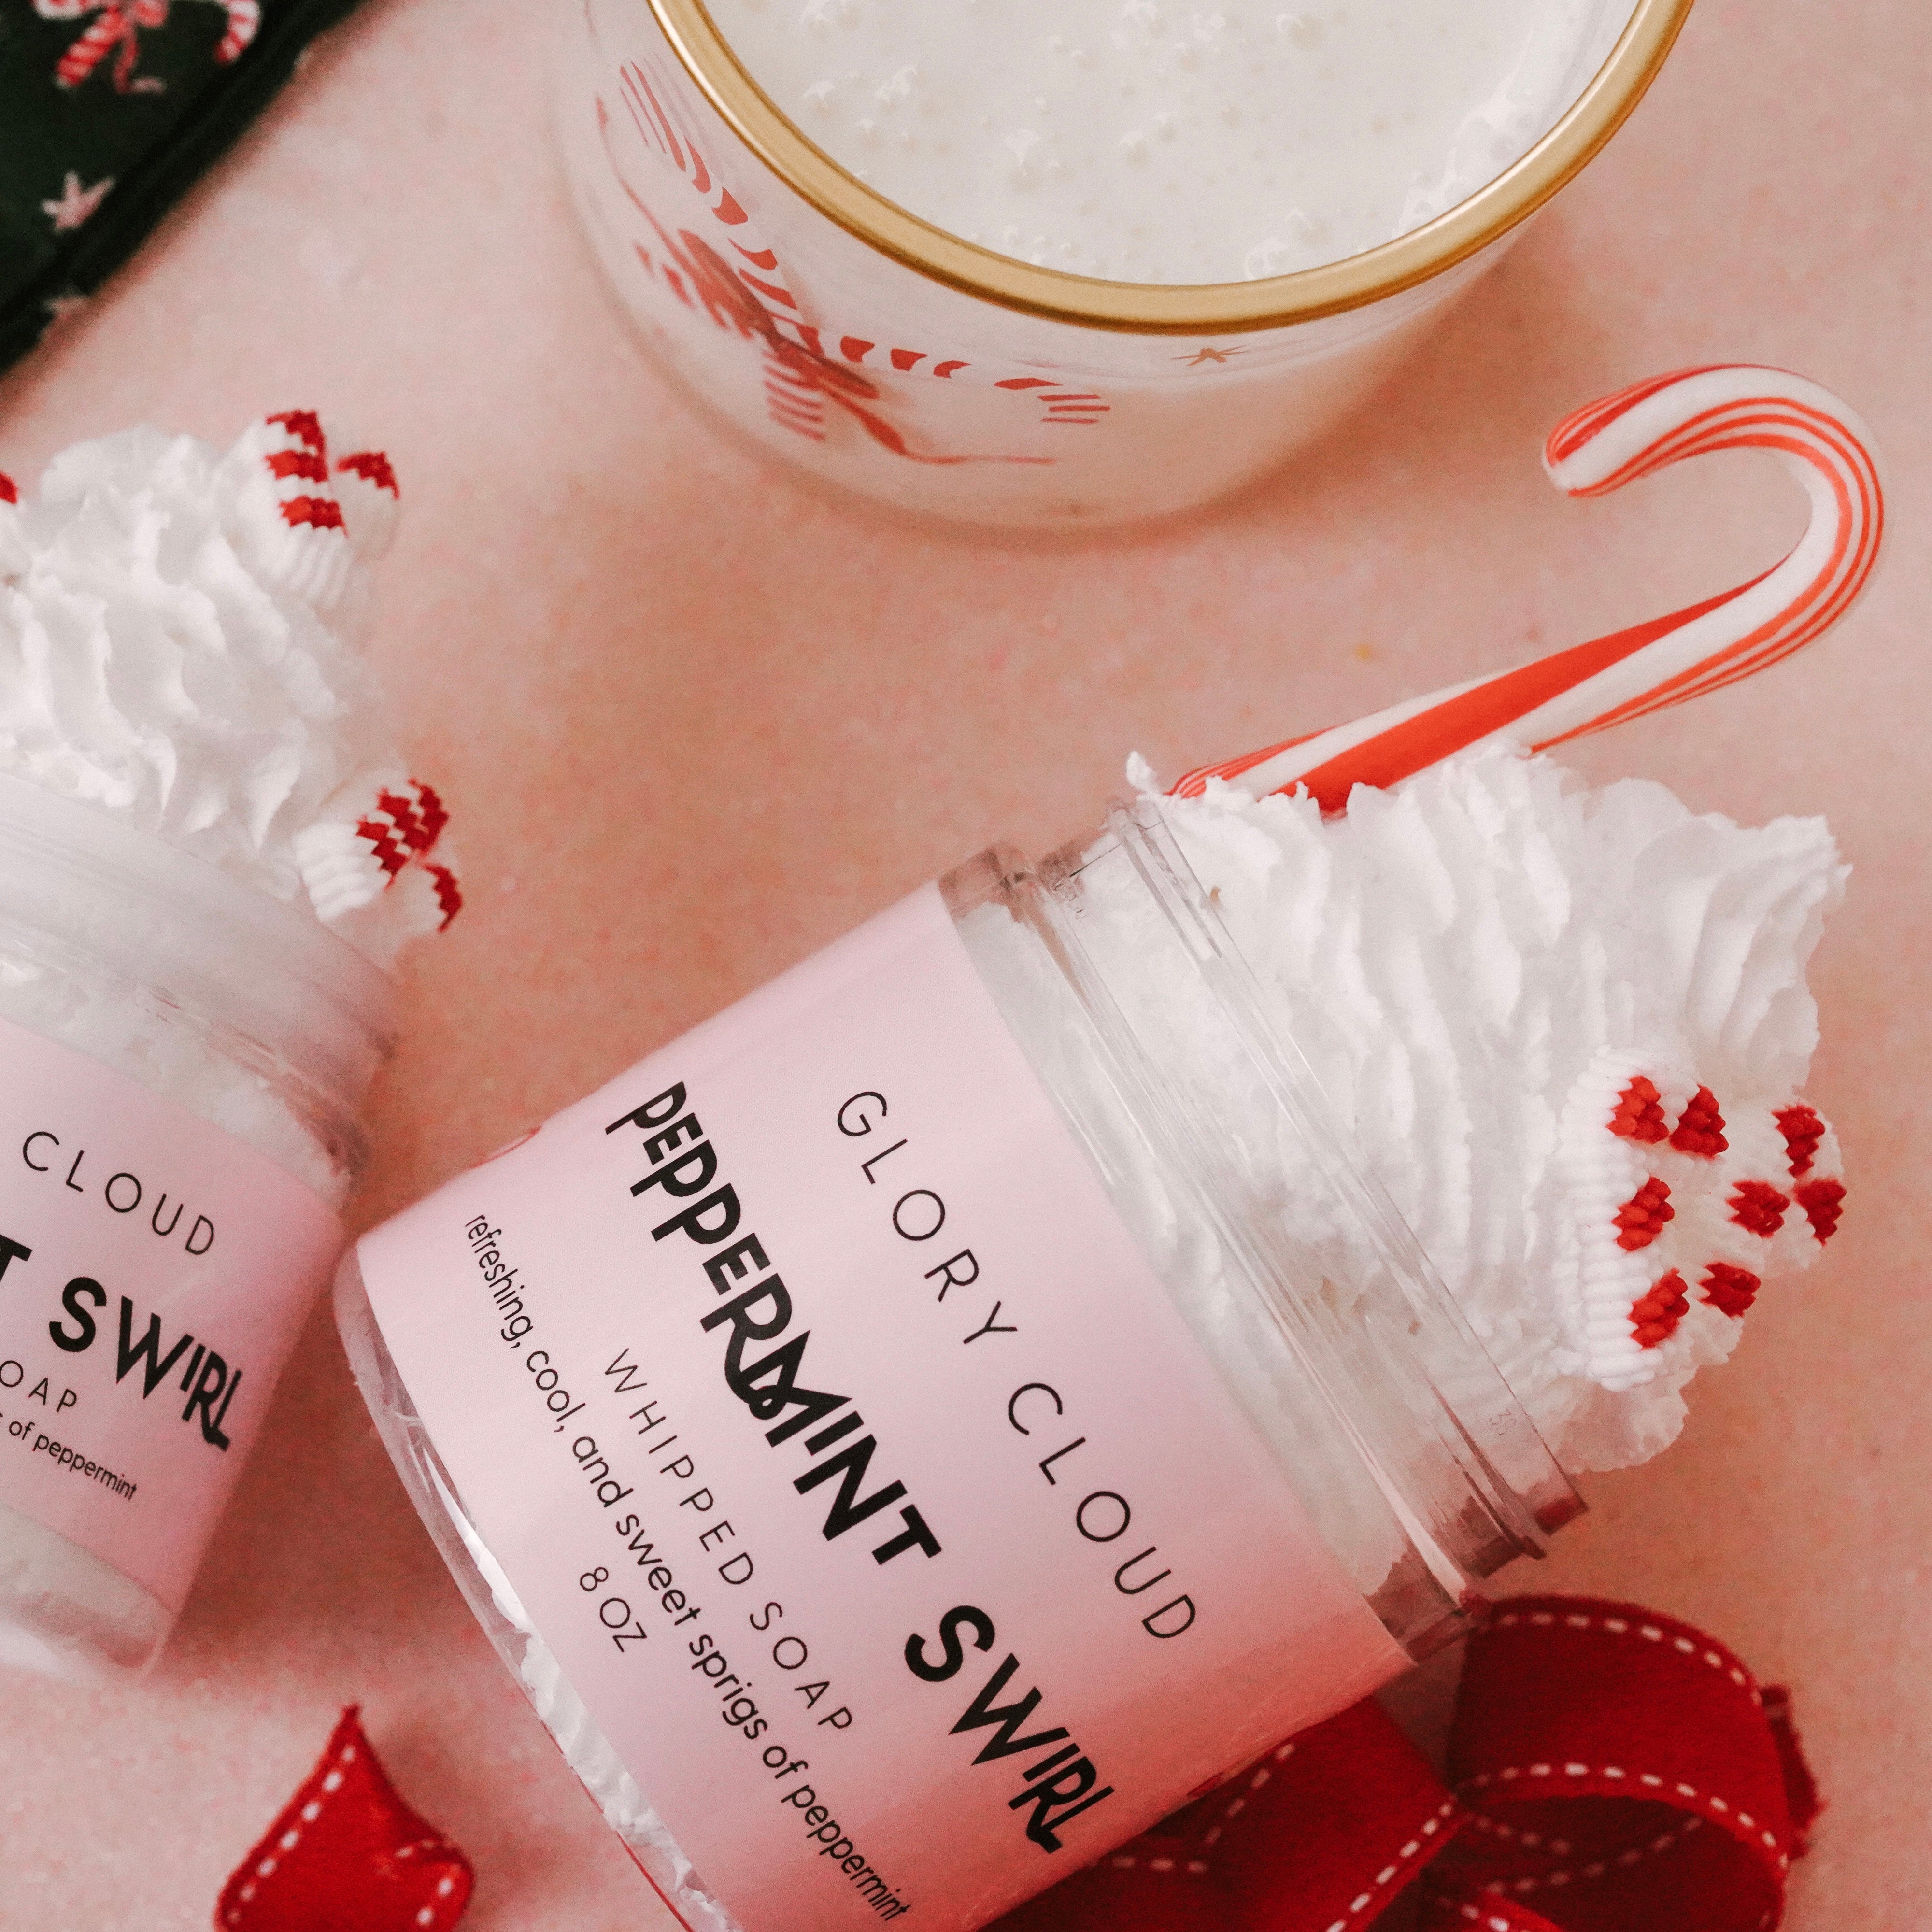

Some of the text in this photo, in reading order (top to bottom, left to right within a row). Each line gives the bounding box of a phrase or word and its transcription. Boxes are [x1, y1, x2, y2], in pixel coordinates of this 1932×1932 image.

[23, 1131, 214, 1255] CLOUD
[0, 1360, 77, 1412] OAP
[49, 1277, 242, 1451] SWIRL
[838, 1092, 1196, 1639] GLORY CLOUD
[9, 1421, 137, 1500] of peppermint
[605, 1081, 1113, 1852] PEPPERMINT SWIRL
[605, 1349, 852, 1729] WHIPPED SOAP
[465, 1215, 910, 1921] refreshing, cool, and sweet sprigs of peppermint
[580, 1567, 647, 1652] 8 OZ
